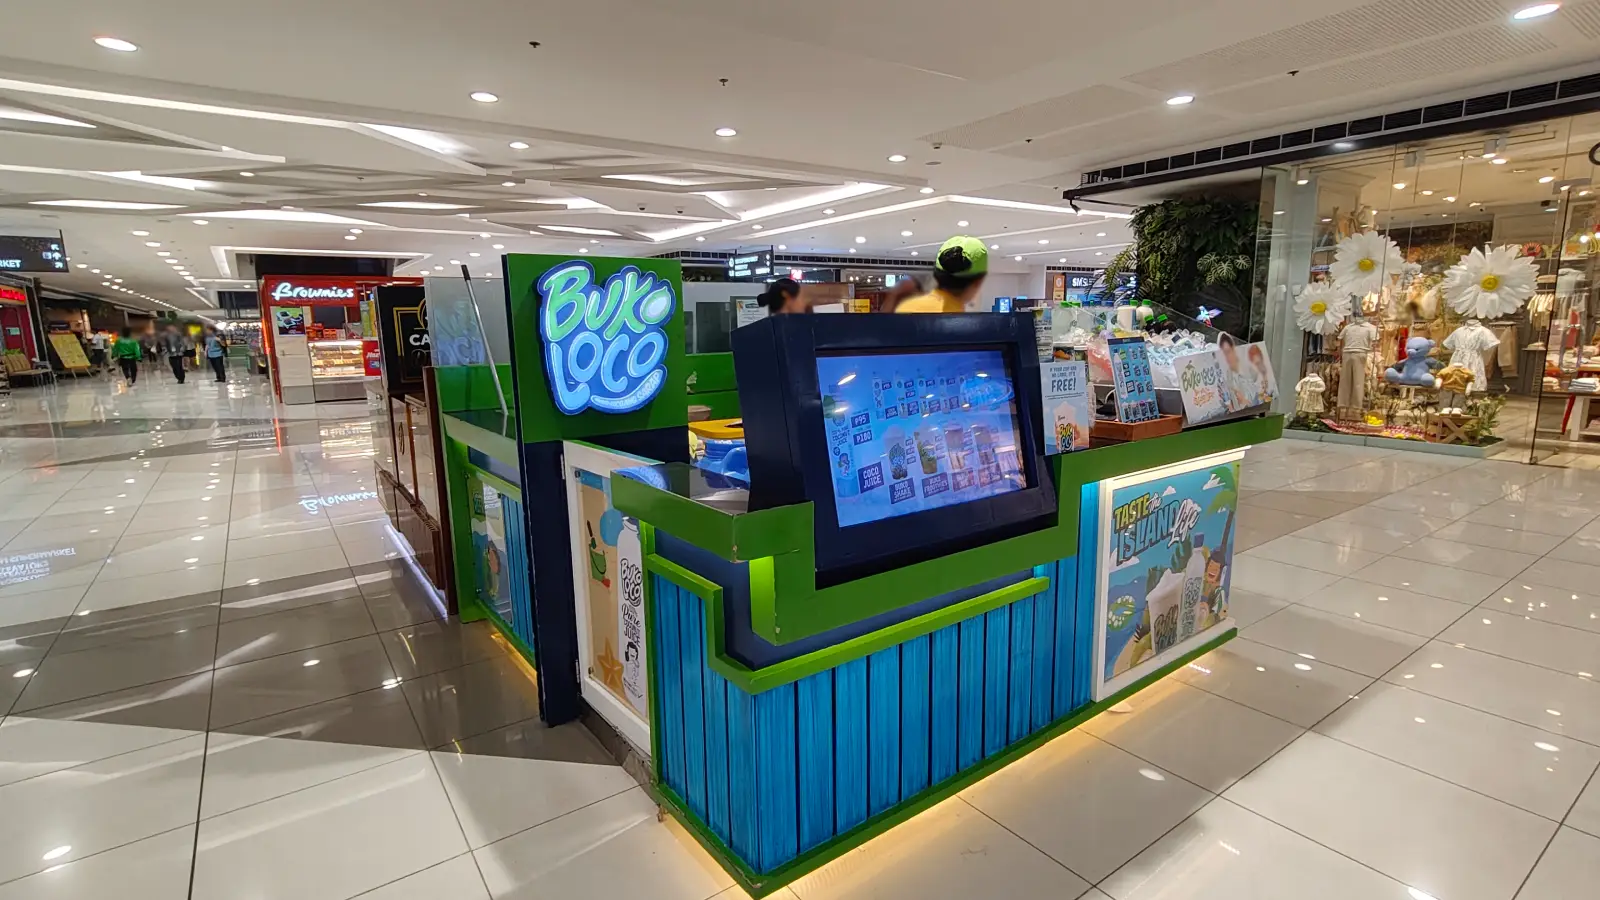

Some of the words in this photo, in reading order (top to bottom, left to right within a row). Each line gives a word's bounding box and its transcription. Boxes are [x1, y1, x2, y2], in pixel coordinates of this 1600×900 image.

[271, 282, 354, 301] Brownies
[551, 331, 664, 411] LOCO
[1051, 377, 1077, 392] FREE!
[854, 414, 867, 426] P95
[863, 466, 879, 480] COCO
[864, 475, 881, 489] JUICE
[1114, 493, 1150, 531] TASTE
[1116, 500, 1180, 566] ISLAND
[622, 603, 641, 628] Pure
